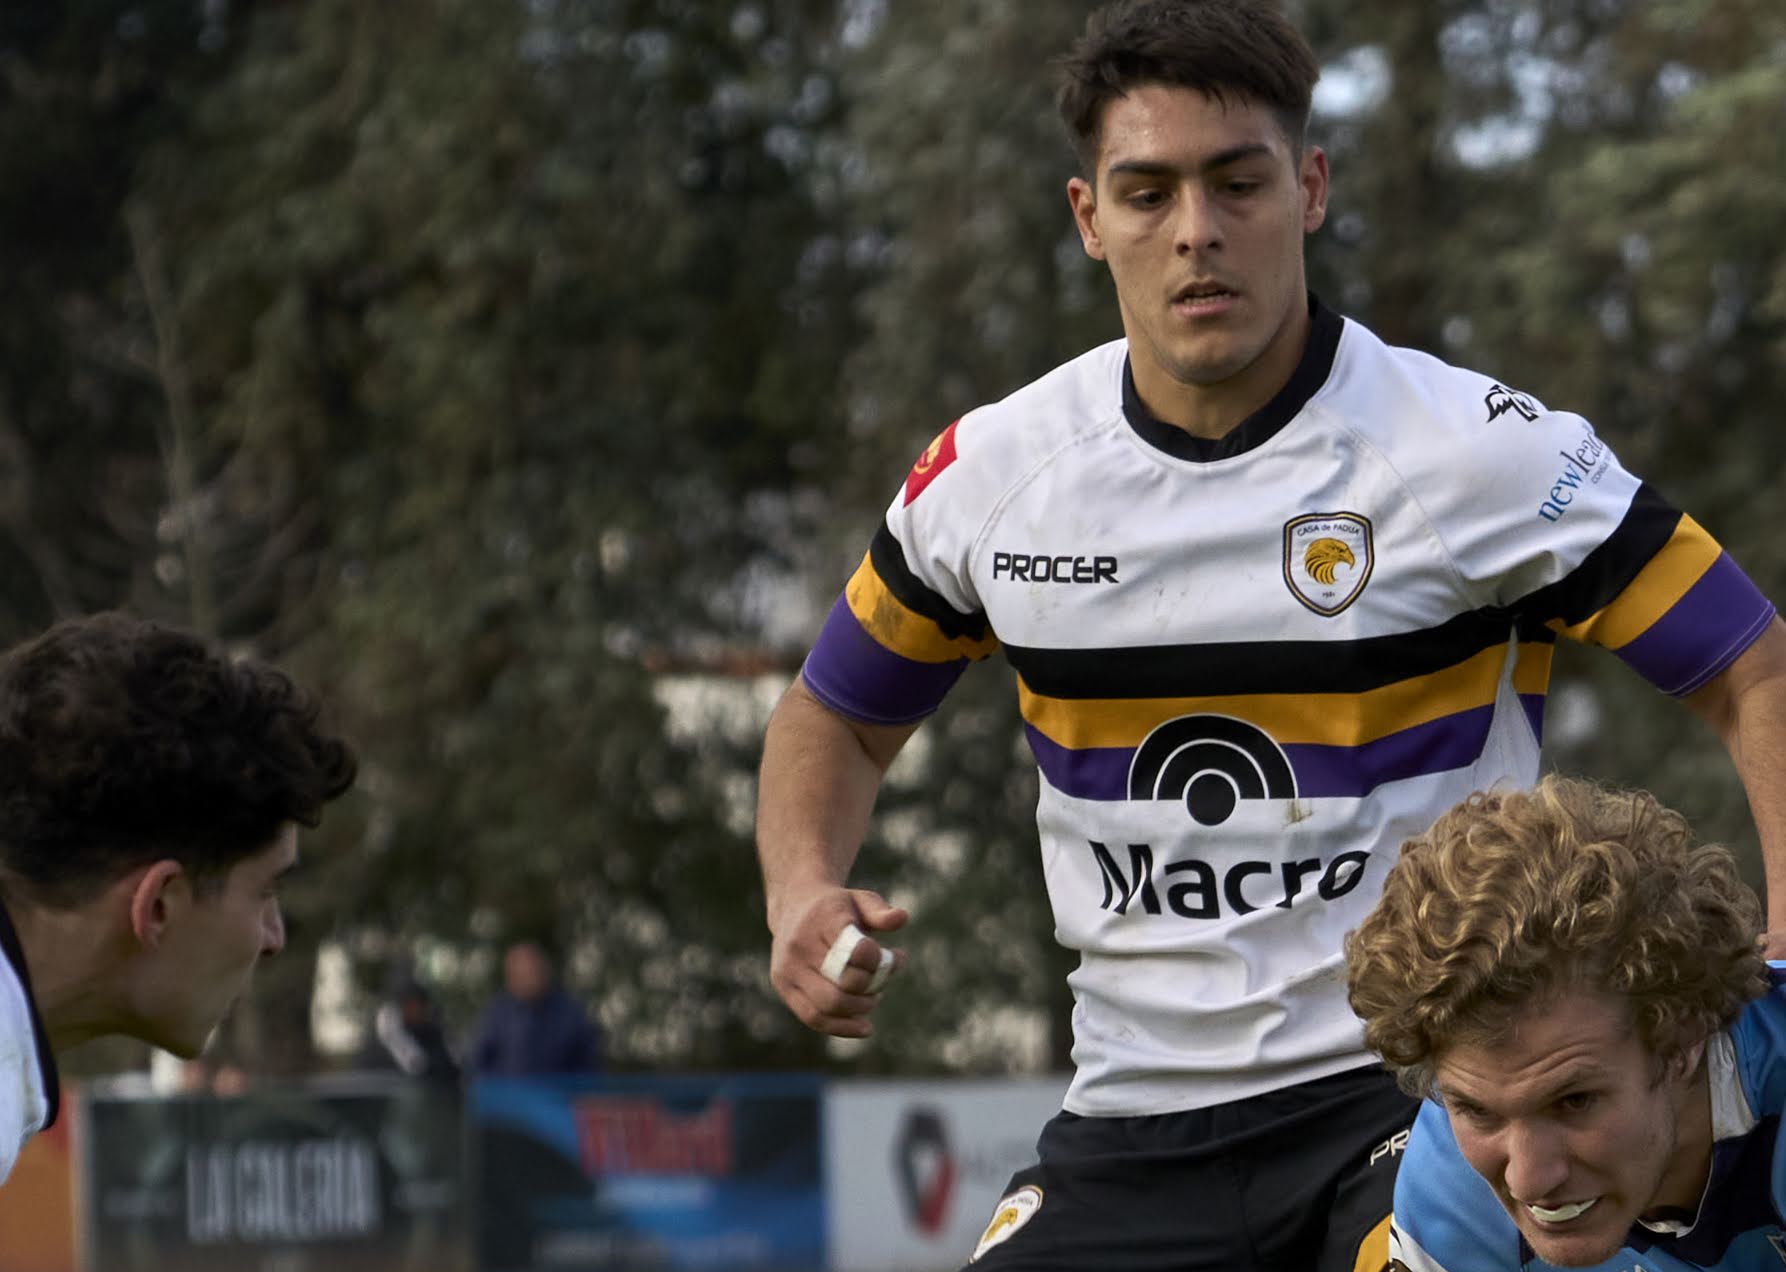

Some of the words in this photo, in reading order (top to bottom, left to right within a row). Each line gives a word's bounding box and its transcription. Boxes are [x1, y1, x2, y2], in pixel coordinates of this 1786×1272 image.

[1297, 524, 1320, 537] CASA
[992, 551, 1120, 584] PROCER
[1088, 839, 1372, 920] Macro
